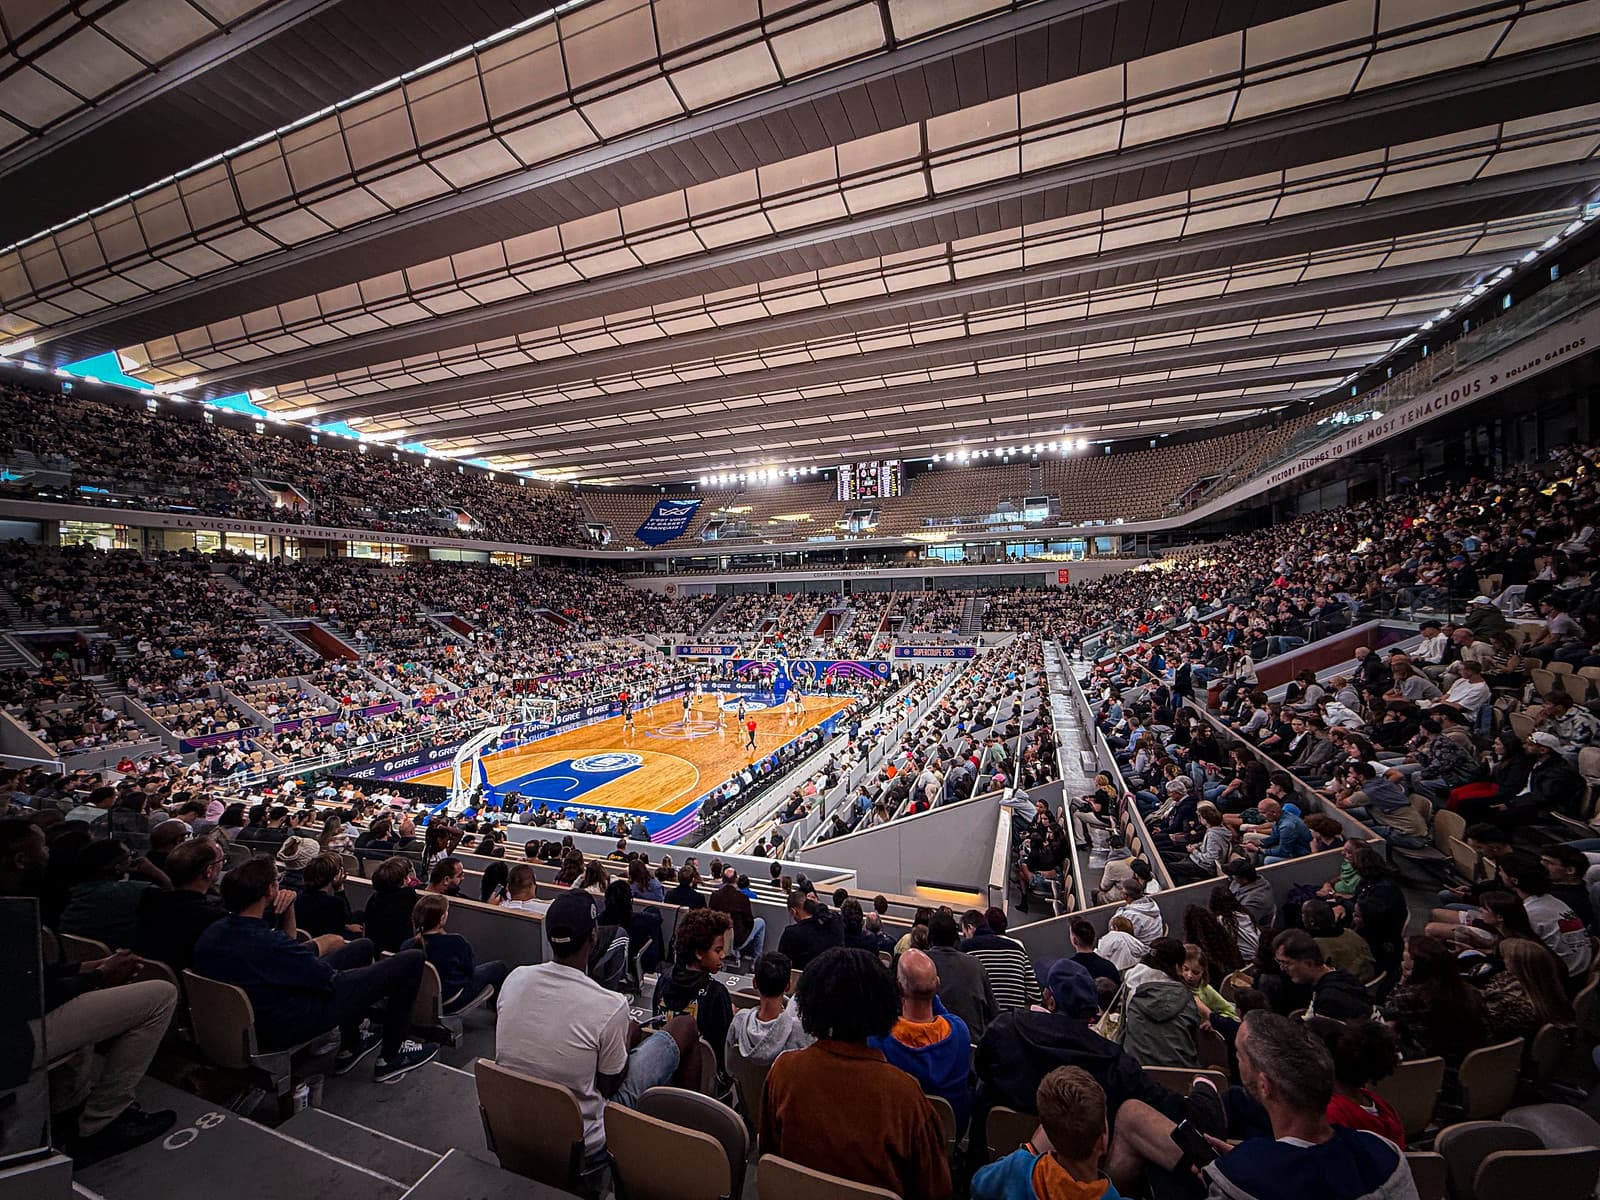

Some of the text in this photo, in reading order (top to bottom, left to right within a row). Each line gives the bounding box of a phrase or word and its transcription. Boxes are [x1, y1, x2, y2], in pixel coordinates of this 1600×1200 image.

[1505, 337, 1586, 378] ROLAND GARROS
[1271, 466, 1296, 483] VICTORY
[1298, 450, 1329, 471] BELONGS
[1332, 445, 1343, 456] TO
[1346, 435, 1363, 450] THE
[1367, 419, 1395, 440] MOST
[1400, 379, 1481, 425] TENACIOUS
[177, 519, 193, 527] LA
[201, 521, 264, 531] VICTOIRE
[270, 527, 337, 538] APPARTIENT
[913, 648, 942, 656] SUPERCOUPE
[593, 703, 610, 714] GREE
[562, 711, 581, 724] GREE
[437, 745, 460, 757] GREE
[394, 755, 420, 769] GREE
